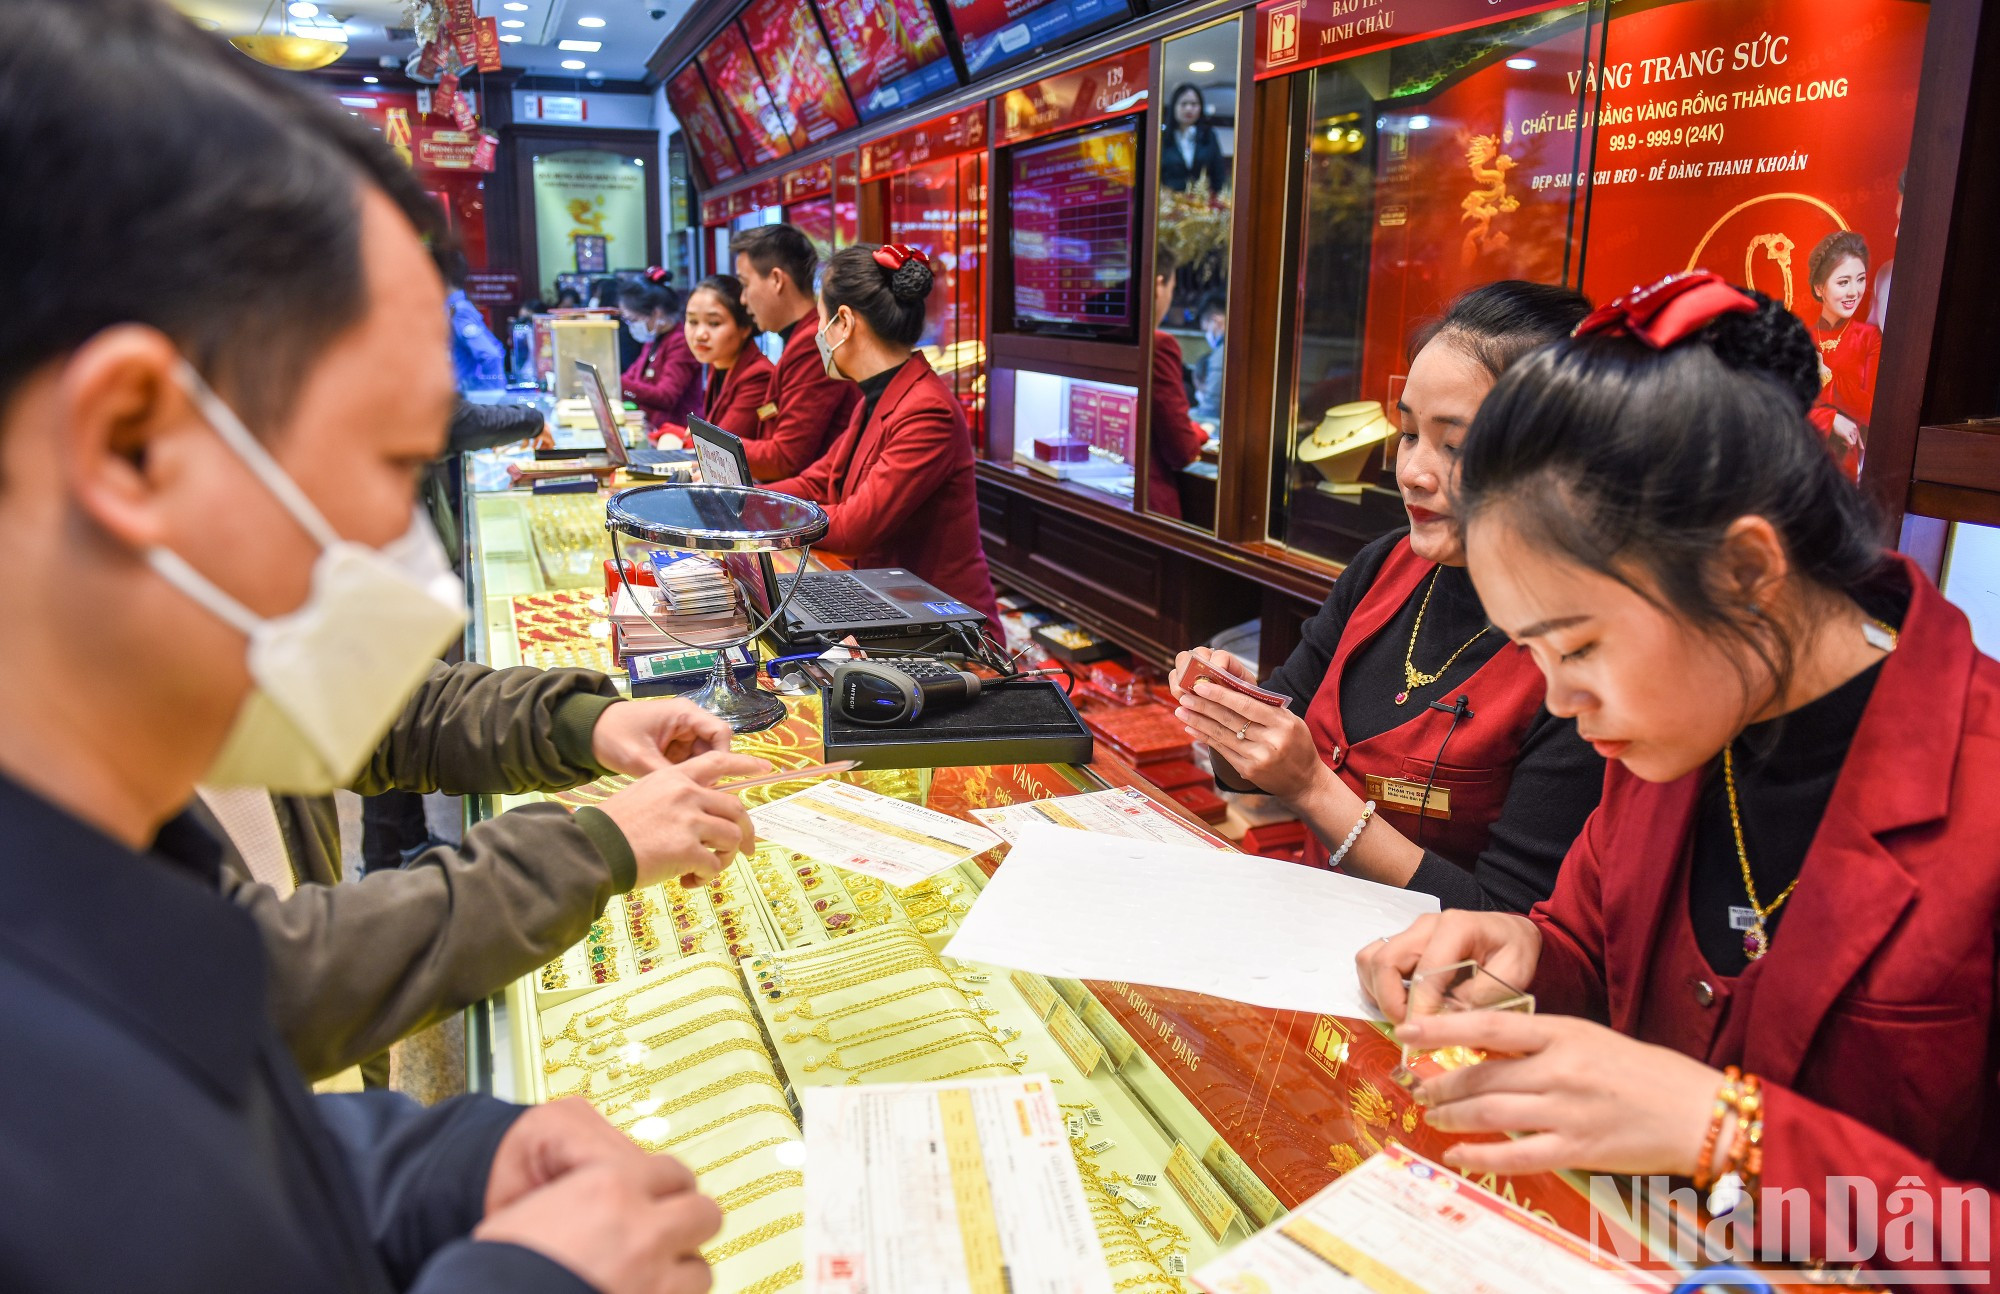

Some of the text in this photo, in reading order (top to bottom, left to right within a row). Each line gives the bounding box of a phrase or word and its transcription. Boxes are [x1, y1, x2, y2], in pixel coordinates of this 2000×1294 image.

[1320, 9, 1394, 46] MINH CHÂU
[1106, 66, 1124, 87] 139
[1567, 31, 1789, 94] VÀNG TRANG SỨC
[1521, 110, 1555, 136] CHẤT
[1637, 99, 1678, 122] VÀNG
[1681, 89, 1728, 117] RỒNG
[1731, 84, 1792, 111] THĂNG
[1795, 77, 1849, 103] LONG
[1609, 133, 1637, 152] 99.9
[1646, 128, 1683, 148] 999.9
[1685, 122, 1725, 148] (24K)
[1613, 168, 1637, 184] ĐEO
[1648, 159, 1666, 181] DỄ
[1667, 160, 1703, 180] DÀNG
[1706, 158, 1753, 177] THANH
[1755, 149, 1809, 174] KHOẢN
[1012, 764, 1043, 800] VÀNG
[1127, 989, 1160, 1030] KHOẢN
[1157, 1021, 1177, 1044] DỄ
